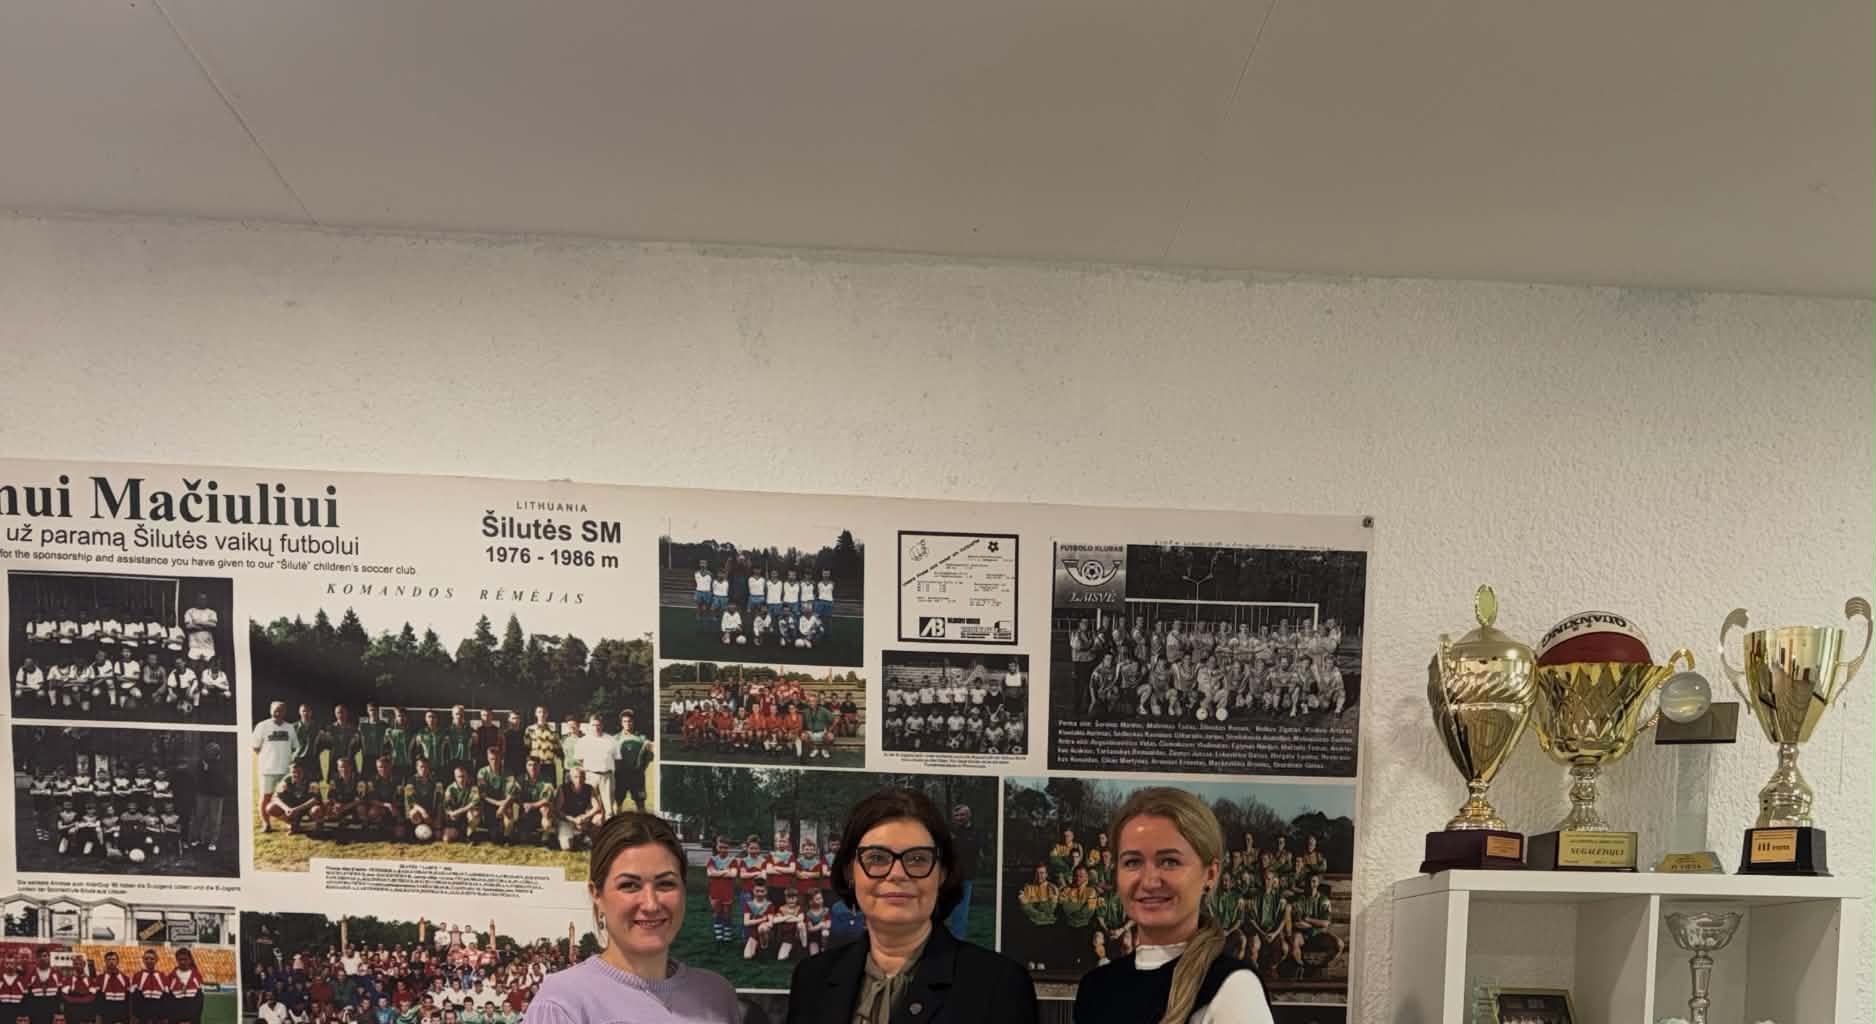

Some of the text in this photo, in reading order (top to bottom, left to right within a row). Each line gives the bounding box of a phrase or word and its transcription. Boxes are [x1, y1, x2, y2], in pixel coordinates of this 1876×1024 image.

[89, 476, 341, 528] Mačiuliui
[515, 500, 588, 513] LITHUANIA
[481, 510, 622, 543] Šilutės SM
[7, 524, 360, 557] už paramą Šilutės vaikų futbolui
[0, 548, 12, 559] for
[15, 549, 30, 559] the
[33, 550, 93, 563] sponsorship
[95, 553, 114, 562] and
[117, 554, 168, 565] assistance
[171, 558, 189, 568] you
[191, 557, 215, 567] have
[218, 558, 243, 568] given
[246, 560, 256, 568] to
[258, 561, 274, 569] our
[313, 562, 359, 573] children's
[361, 565, 394, 574] soccer
[395, 565, 416, 575] club
[485, 546, 531, 564] 1976
[549, 549, 595, 567] 1986
[601, 555, 619, 568] m
[326, 583, 455, 599] KOMANDOS
